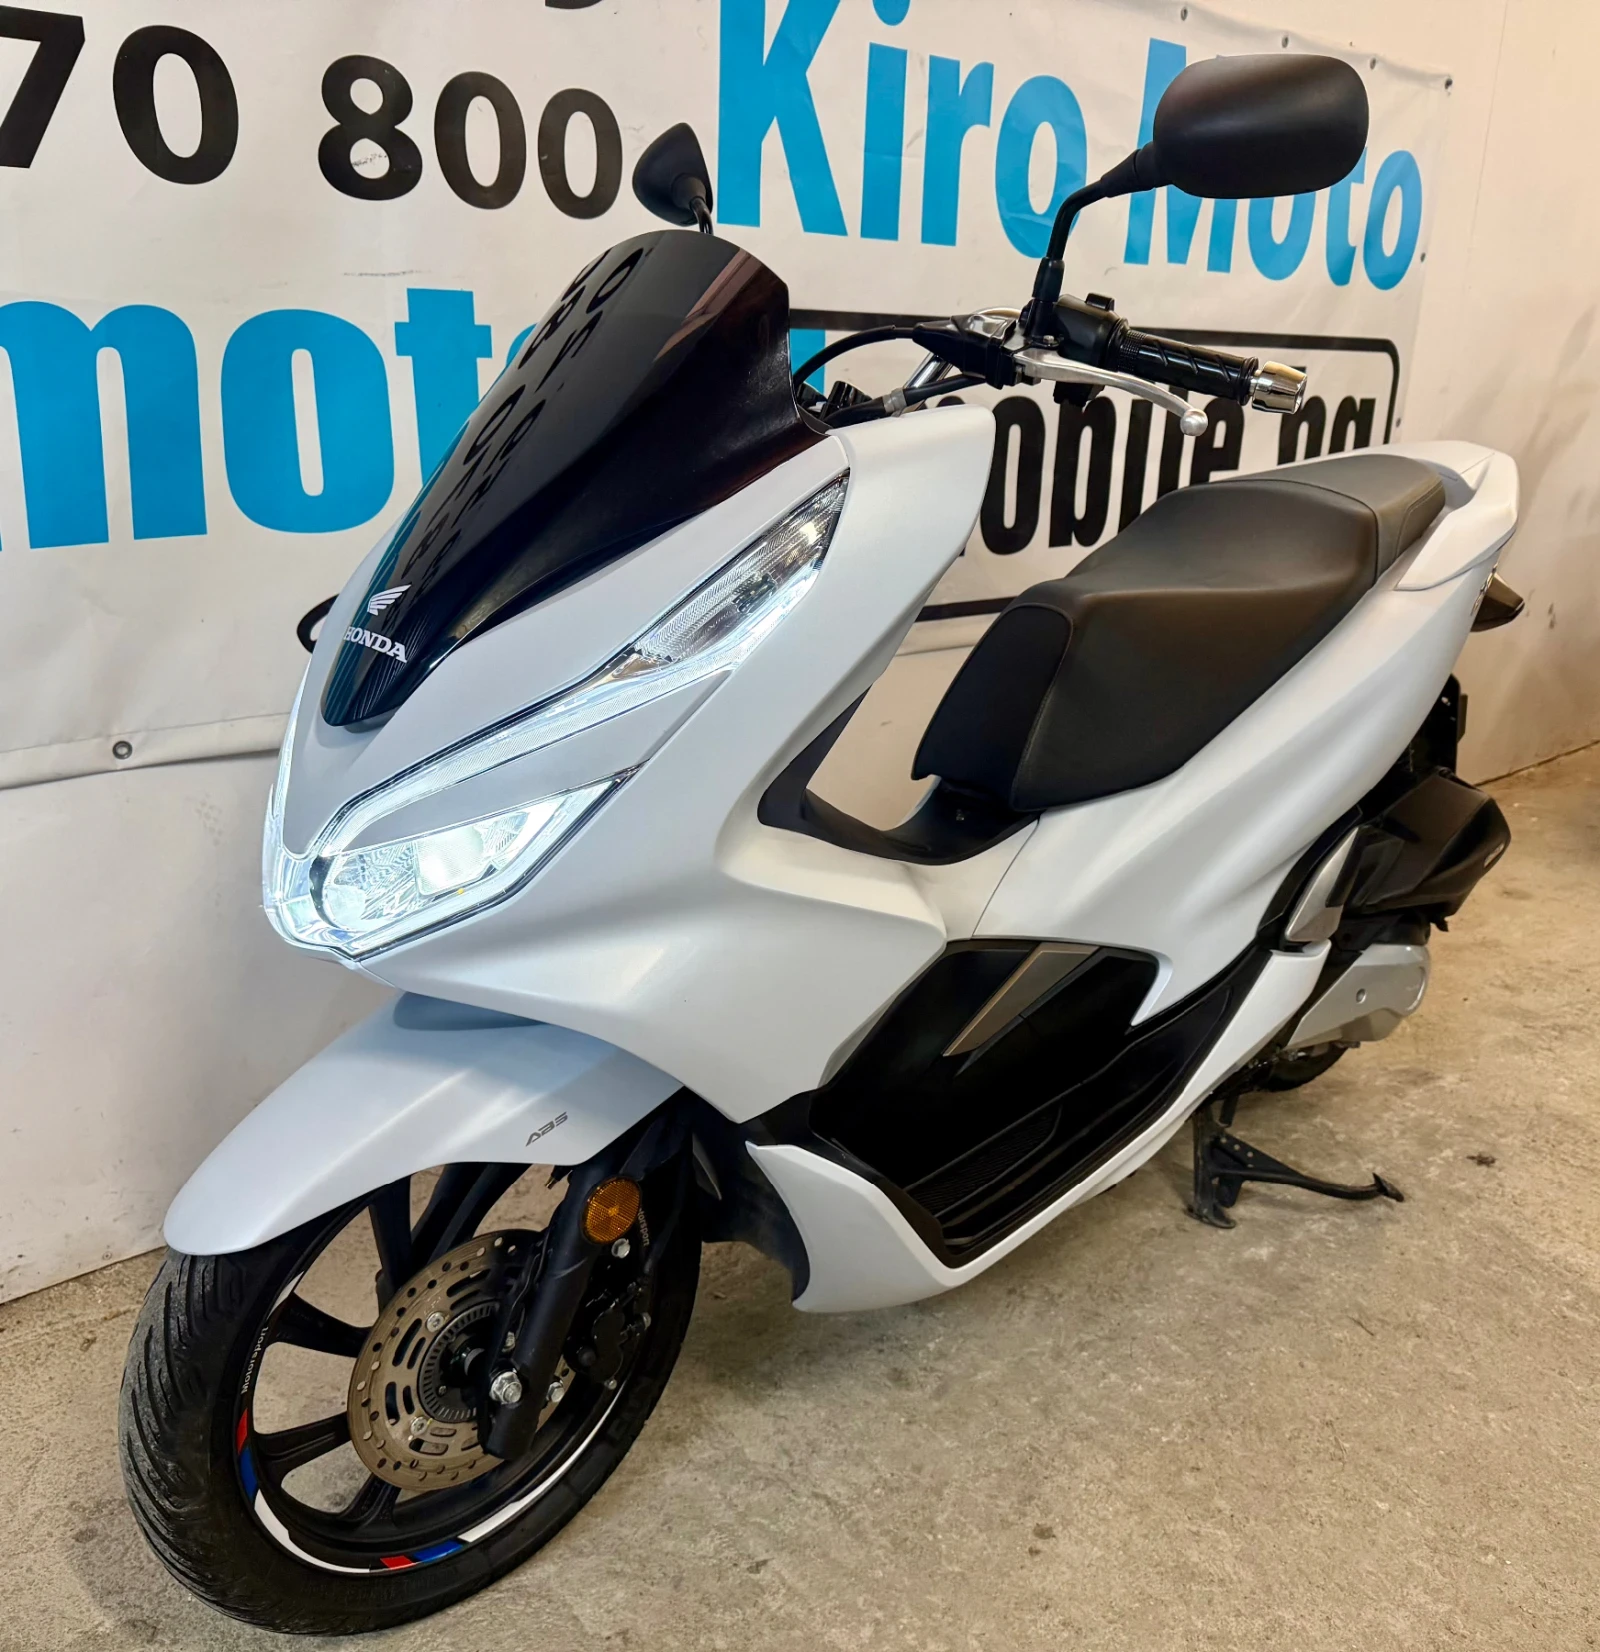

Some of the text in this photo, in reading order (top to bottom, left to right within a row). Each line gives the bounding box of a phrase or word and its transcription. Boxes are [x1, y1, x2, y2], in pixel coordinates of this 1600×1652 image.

[0, 6, 623, 220] 70 800
[716, 0, 1088, 258] Kiro
[0, 287, 541, 551] mot
[343, 626, 408, 664] HONDA
[525, 1110, 569, 1148] ABS
